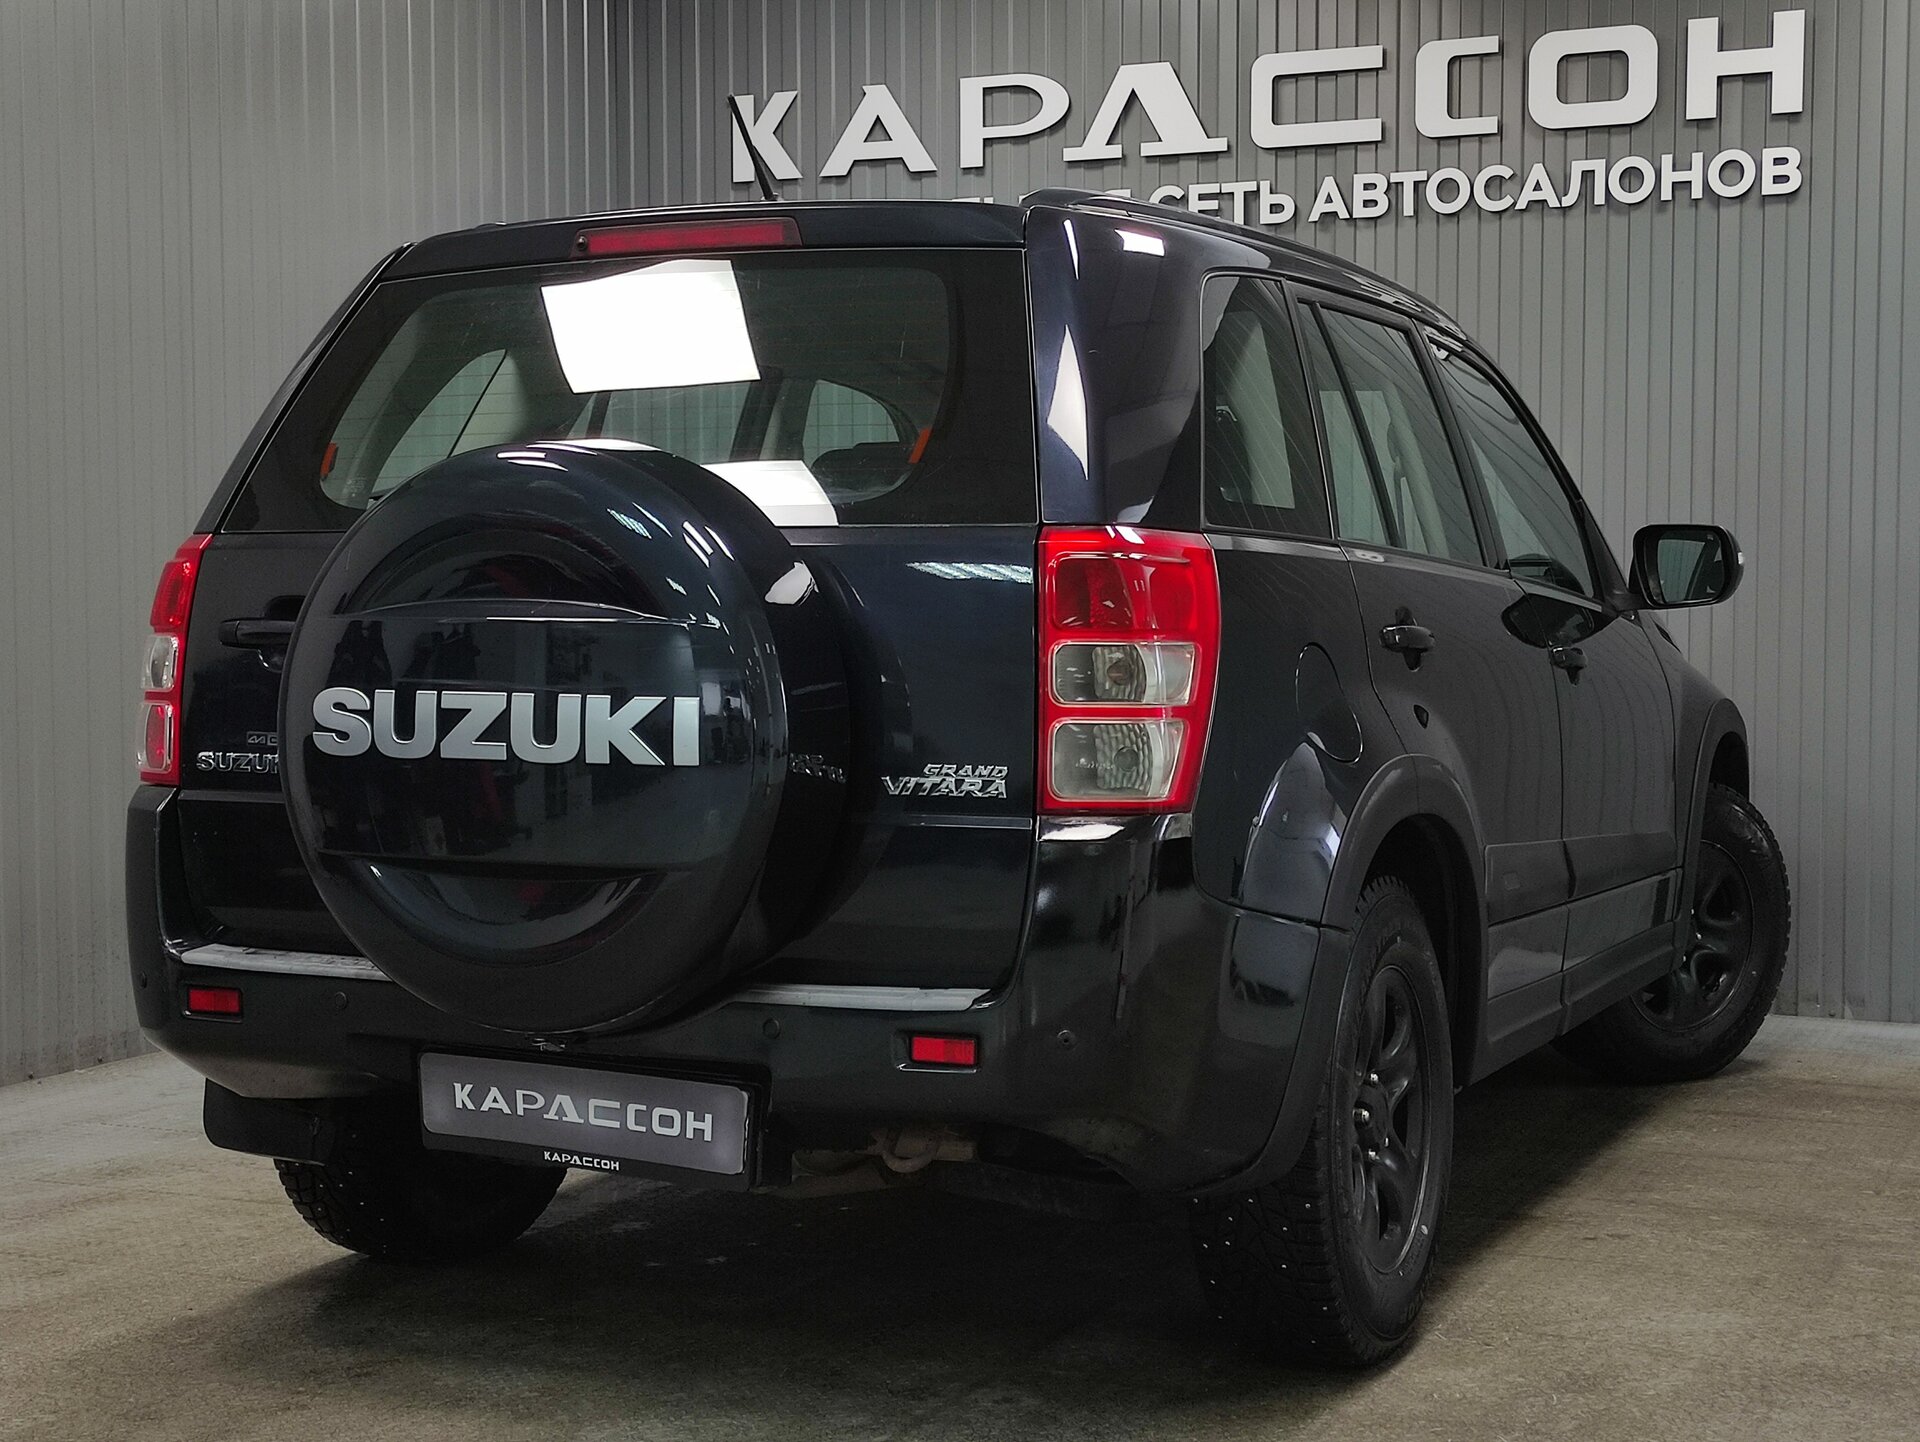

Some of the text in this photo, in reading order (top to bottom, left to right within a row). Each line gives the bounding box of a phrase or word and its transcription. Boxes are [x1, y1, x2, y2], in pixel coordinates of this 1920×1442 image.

[1308, 146, 1803, 222] АВТОСАЛОНОВ
[312, 687, 700, 766] SUZUKI
[881, 776, 1007, 798] VITARA
[923, 763, 1008, 778] GRAND
